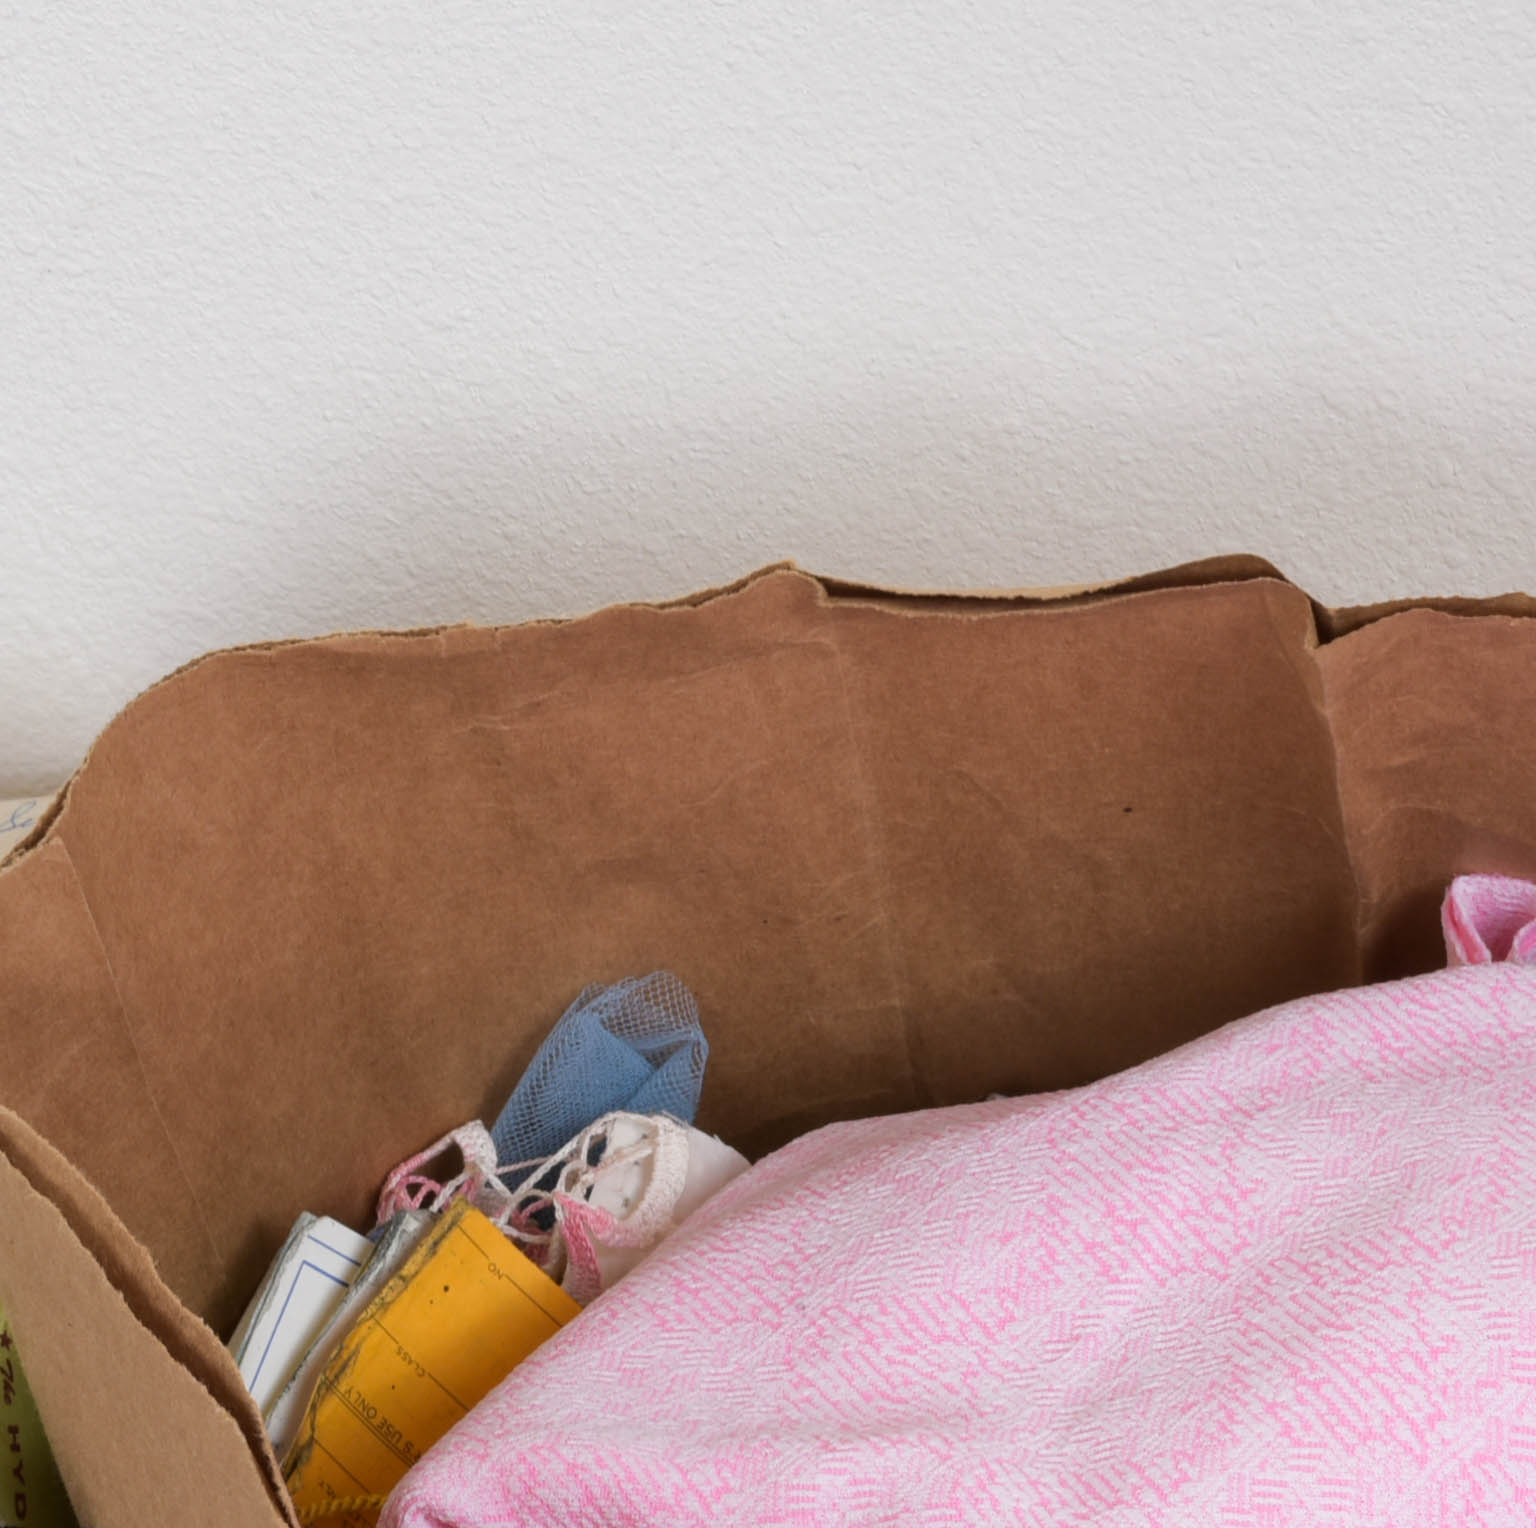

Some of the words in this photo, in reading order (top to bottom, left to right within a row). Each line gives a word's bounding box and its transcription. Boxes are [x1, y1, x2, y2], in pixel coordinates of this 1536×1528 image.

[395, 1345, 426, 1377] CLASS
[343, 1386, 379, 1420] ONLY
[376, 1416, 403, 1445] USE
